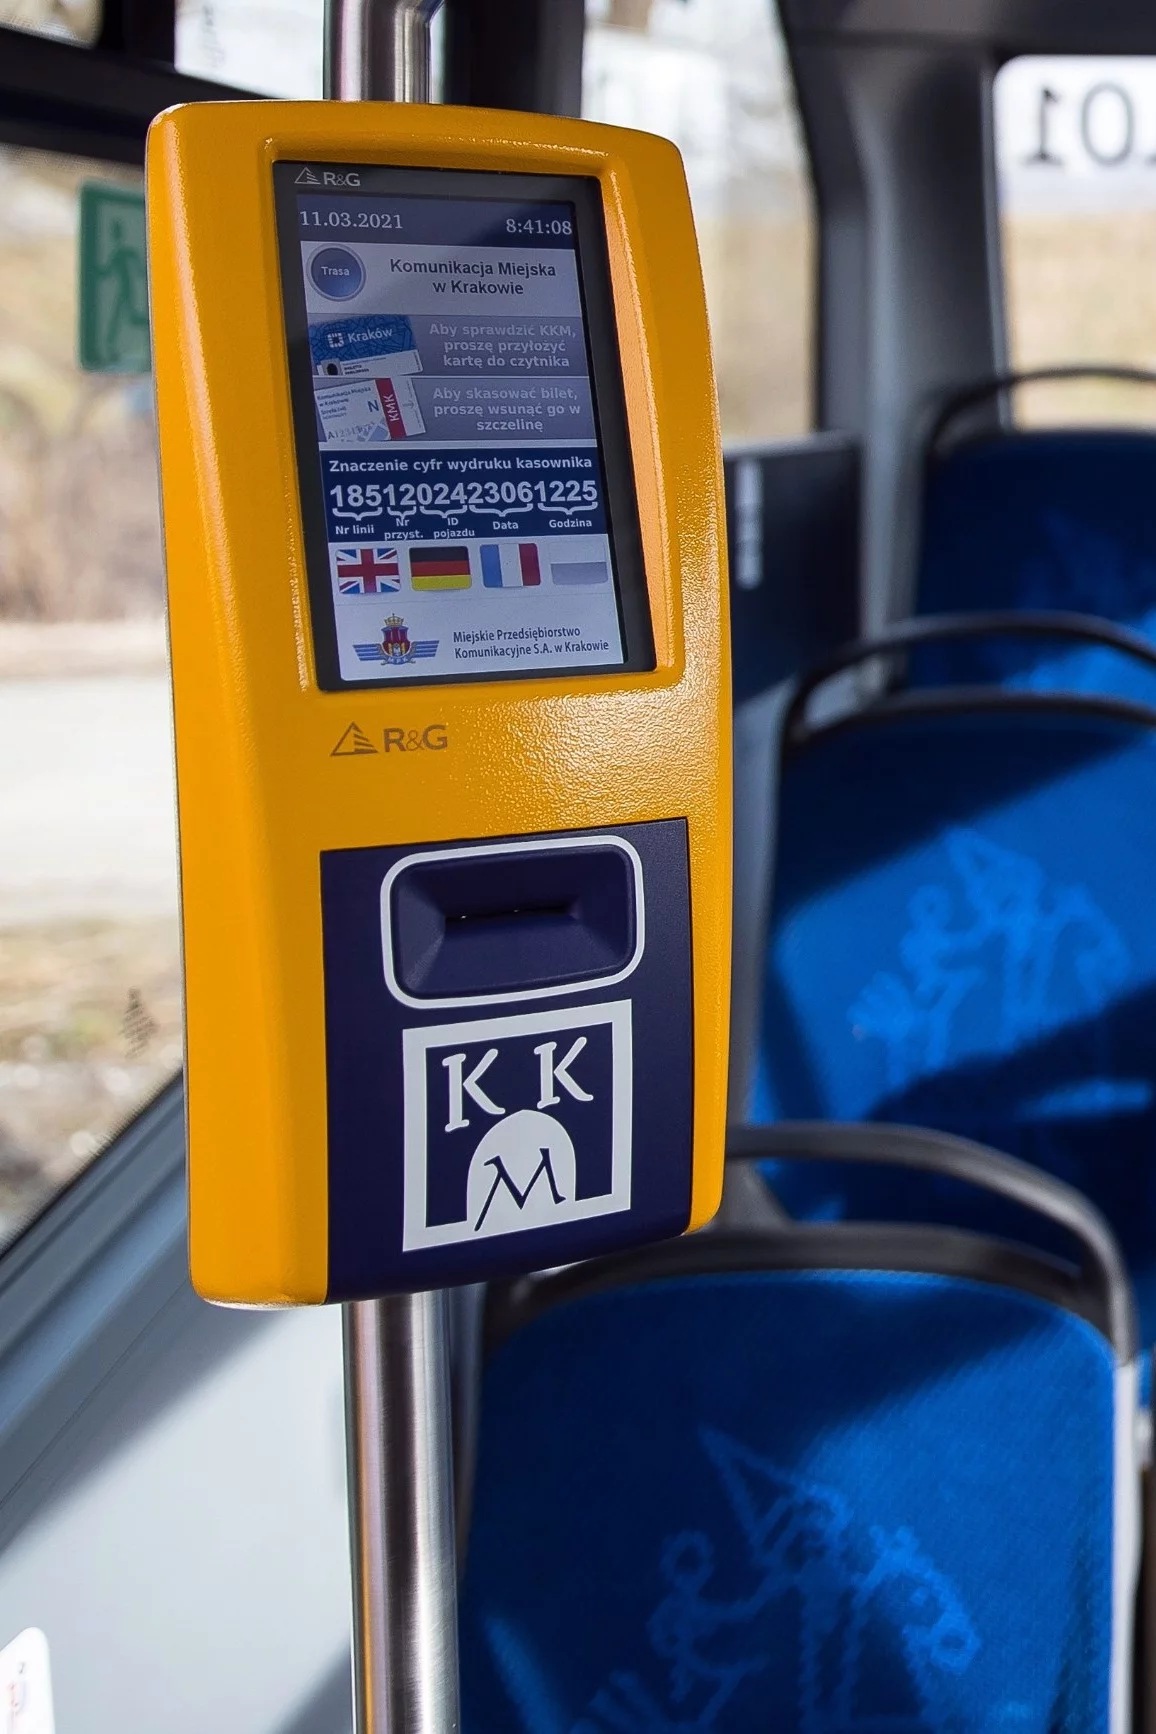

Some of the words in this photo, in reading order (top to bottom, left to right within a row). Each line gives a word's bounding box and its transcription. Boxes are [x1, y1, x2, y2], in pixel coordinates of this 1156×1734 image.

[323, 172, 361, 187] R&G
[300, 211, 403, 229] 11.03.2021
[506, 218, 572, 235] 8:41:08
[321, 266, 350, 277] Trasa
[390, 258, 494, 276] Komunikacja
[498, 262, 556, 278] Miejska
[433, 283, 446, 294] w
[451, 280, 524, 295] Krakowie
[348, 328, 393, 343] Kraków
[429, 323, 459, 339] Aby
[462, 322, 535, 340] sprawdzić
[539, 325, 577, 339] KKM,
[444, 340, 493, 356] proszę
[498, 339, 566, 356] przyłożyć
[443, 354, 483, 370] kartę
[487, 355, 506, 367] do
[509, 354, 570, 370] czytnika
[433, 387, 461, 403] Aby
[465, 387, 537, 400] skasować
[541, 387, 578, 402] bilet,
[367, 400, 380, 413] N
[383, 394, 400, 422] KMK
[434, 404, 483, 419] proszę
[485, 402, 542, 418] wsunąć
[546, 405, 566, 418] go
[568, 405, 581, 415] w
[476, 418, 544, 434] szczelinę
[329, 459, 409, 473] Znaczenie
[413, 458, 443, 474] cyfr
[447, 457, 511, 473] wydruku
[516, 456, 592, 470] kasownika
[330, 480, 597, 507] 1851202423061225
[396, 517, 409, 526] Nr
[447, 516, 459, 526] ID
[492, 520, 519, 531] Data
[549, 518, 592, 529] Godzina
[335, 526, 350, 535] Nr
[352, 524, 375, 535] linii
[384, 529, 424, 541] przyst.
[433, 527, 475, 539] pojazdu
[453, 630, 495, 644] Miejskie
[497, 626, 581, 641] Przedsiębiorstwo
[454, 645, 532, 660] Komunikacyjne
[533, 642, 553, 655] S.A.
[554, 644, 563, 653] w
[564, 640, 609, 653] Krakowie
[383, 724, 449, 753] R&G
